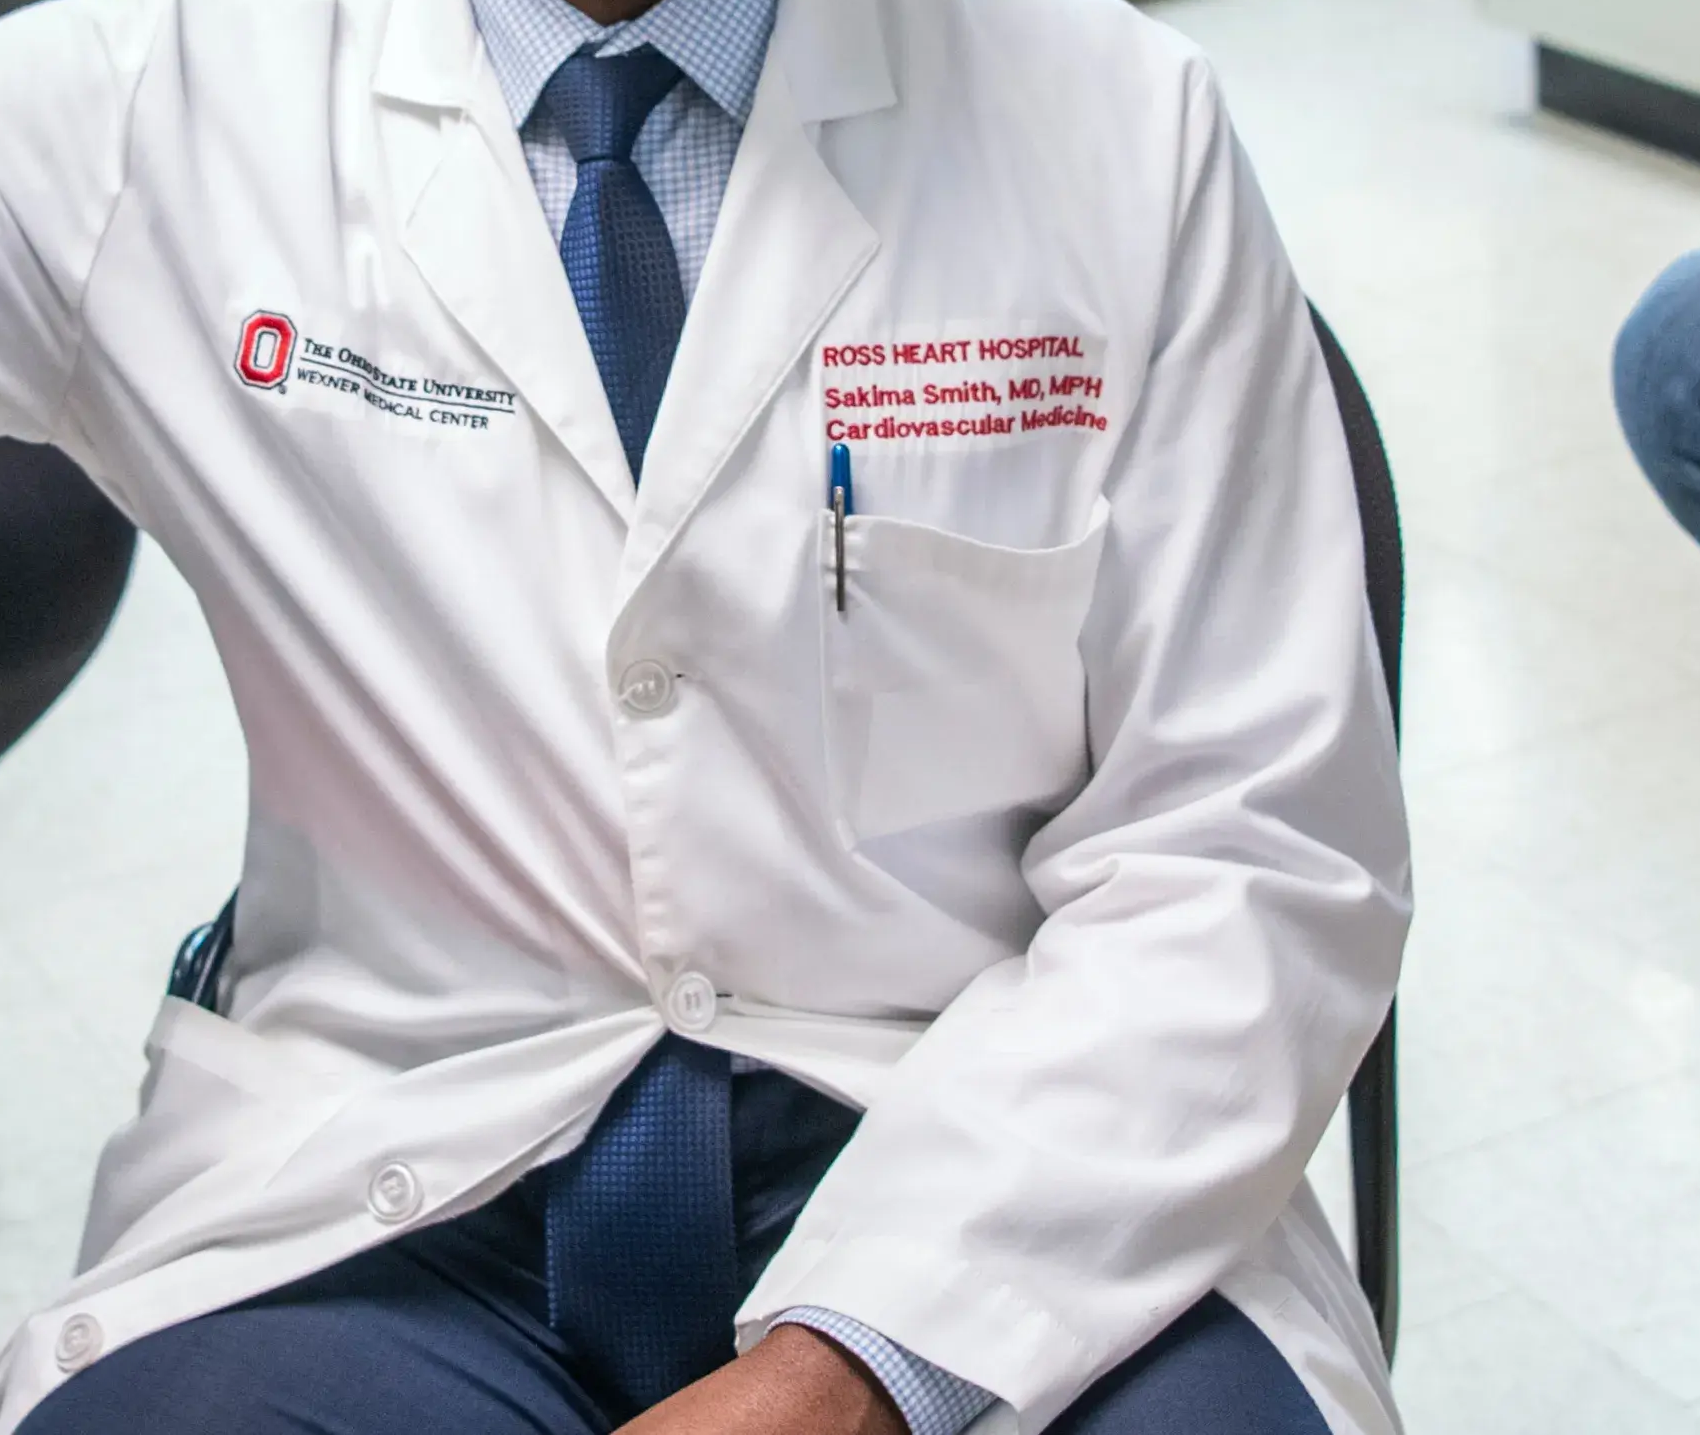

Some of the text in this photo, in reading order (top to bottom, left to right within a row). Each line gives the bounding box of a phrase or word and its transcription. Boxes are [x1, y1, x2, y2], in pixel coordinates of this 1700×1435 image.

[822, 337, 1084, 367] ROSS HEART HOSPITAL
[303, 338, 516, 406] THE OHIO STATE UNIVERSITY
[923, 380, 1001, 405] Smith,
[1008, 378, 1045, 401] MD,
[1049, 375, 1103, 399] MPH
[297, 367, 489, 430] WEXNER MEDICAL CENTER
[826, 404, 1107, 441] Cardiovascular Medicine
